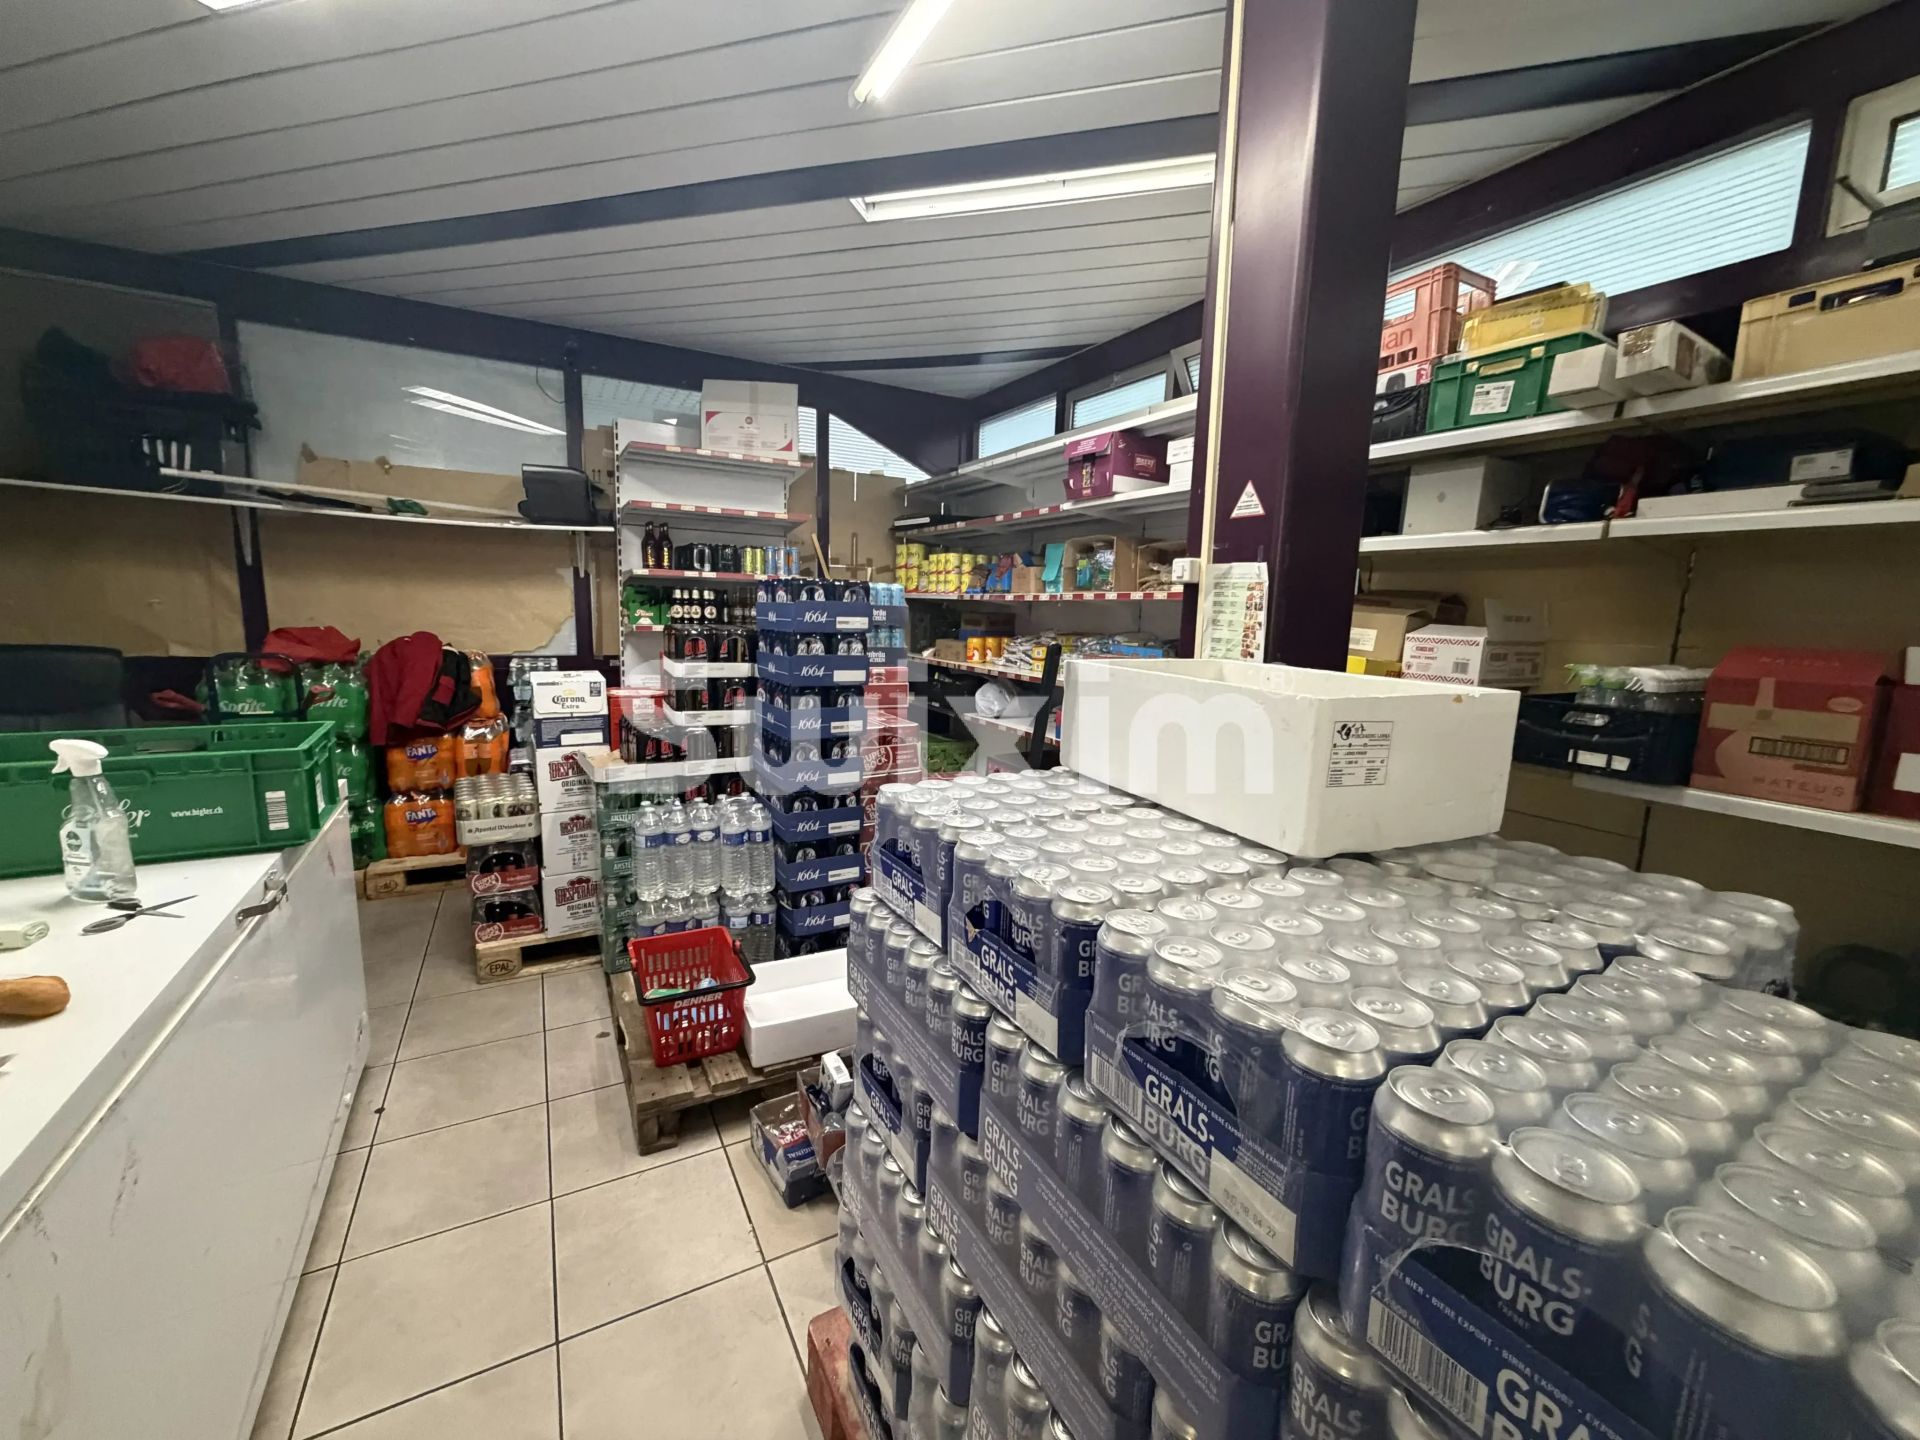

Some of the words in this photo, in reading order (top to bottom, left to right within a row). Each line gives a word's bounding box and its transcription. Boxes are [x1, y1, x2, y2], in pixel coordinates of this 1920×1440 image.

[803, 610, 828, 623] 1664
[800, 664, 826, 677] 1664
[551, 695, 587, 704] Corona
[798, 717, 822, 730] 1664
[406, 744, 437, 756] FANTA
[796, 770, 819, 782] 1664
[1752, 775, 1845, 797] MATEUS
[405, 808, 436, 821] FANTA
[797, 820, 820, 832] 1664
[797, 869, 820, 882] 1664
[804, 915, 826, 927] 1664
[489, 963, 510, 973] EPAL
[980, 944, 1018, 987] GRALS-
[673, 991, 723, 1010] DENNER
[952, 1040, 984, 1063] BURG
[1144, 1074, 1215, 1143] GRALS-
[1143, 1103, 1207, 1178] BURG
[984, 1140, 1018, 1197] BURG
[930, 1207, 958, 1257] BURG
[1485, 1212, 1593, 1301] GRALS-
[1479, 1247, 1575, 1336] BURG
[1405, 1277, 1424, 1296] BIER
[1458, 1316, 1493, 1347] EXPORT
[1292, 1360, 1363, 1435] GRALS
